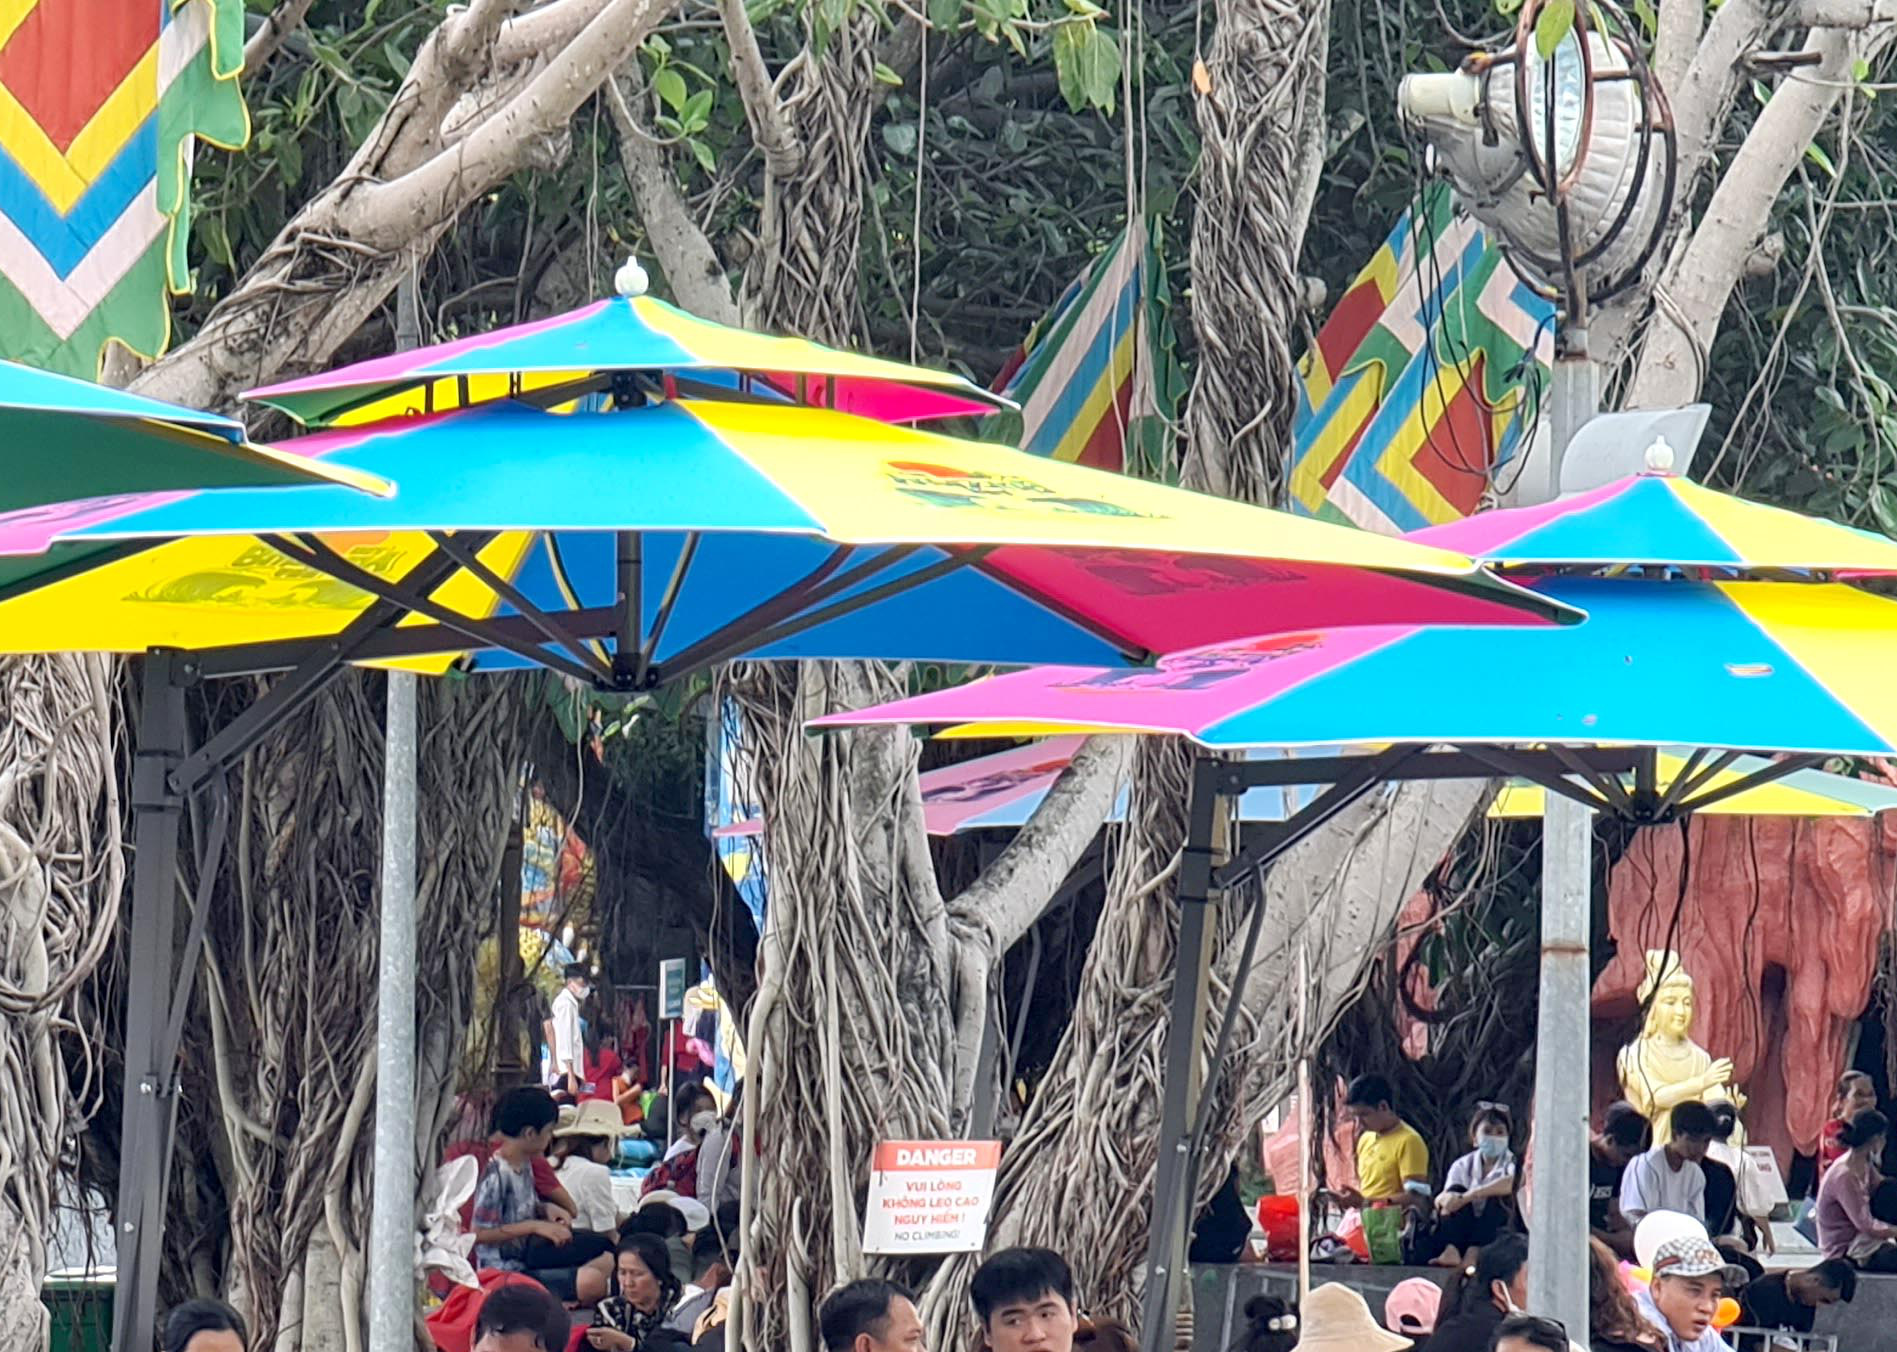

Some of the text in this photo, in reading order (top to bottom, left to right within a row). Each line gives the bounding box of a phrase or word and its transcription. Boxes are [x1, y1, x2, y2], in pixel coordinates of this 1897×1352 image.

[895, 1149, 977, 1166] DANGER
[906, 1181, 927, 1192] VUI
[929, 1197, 952, 1207] LEO
[955, 1197, 980, 1207] CAO
